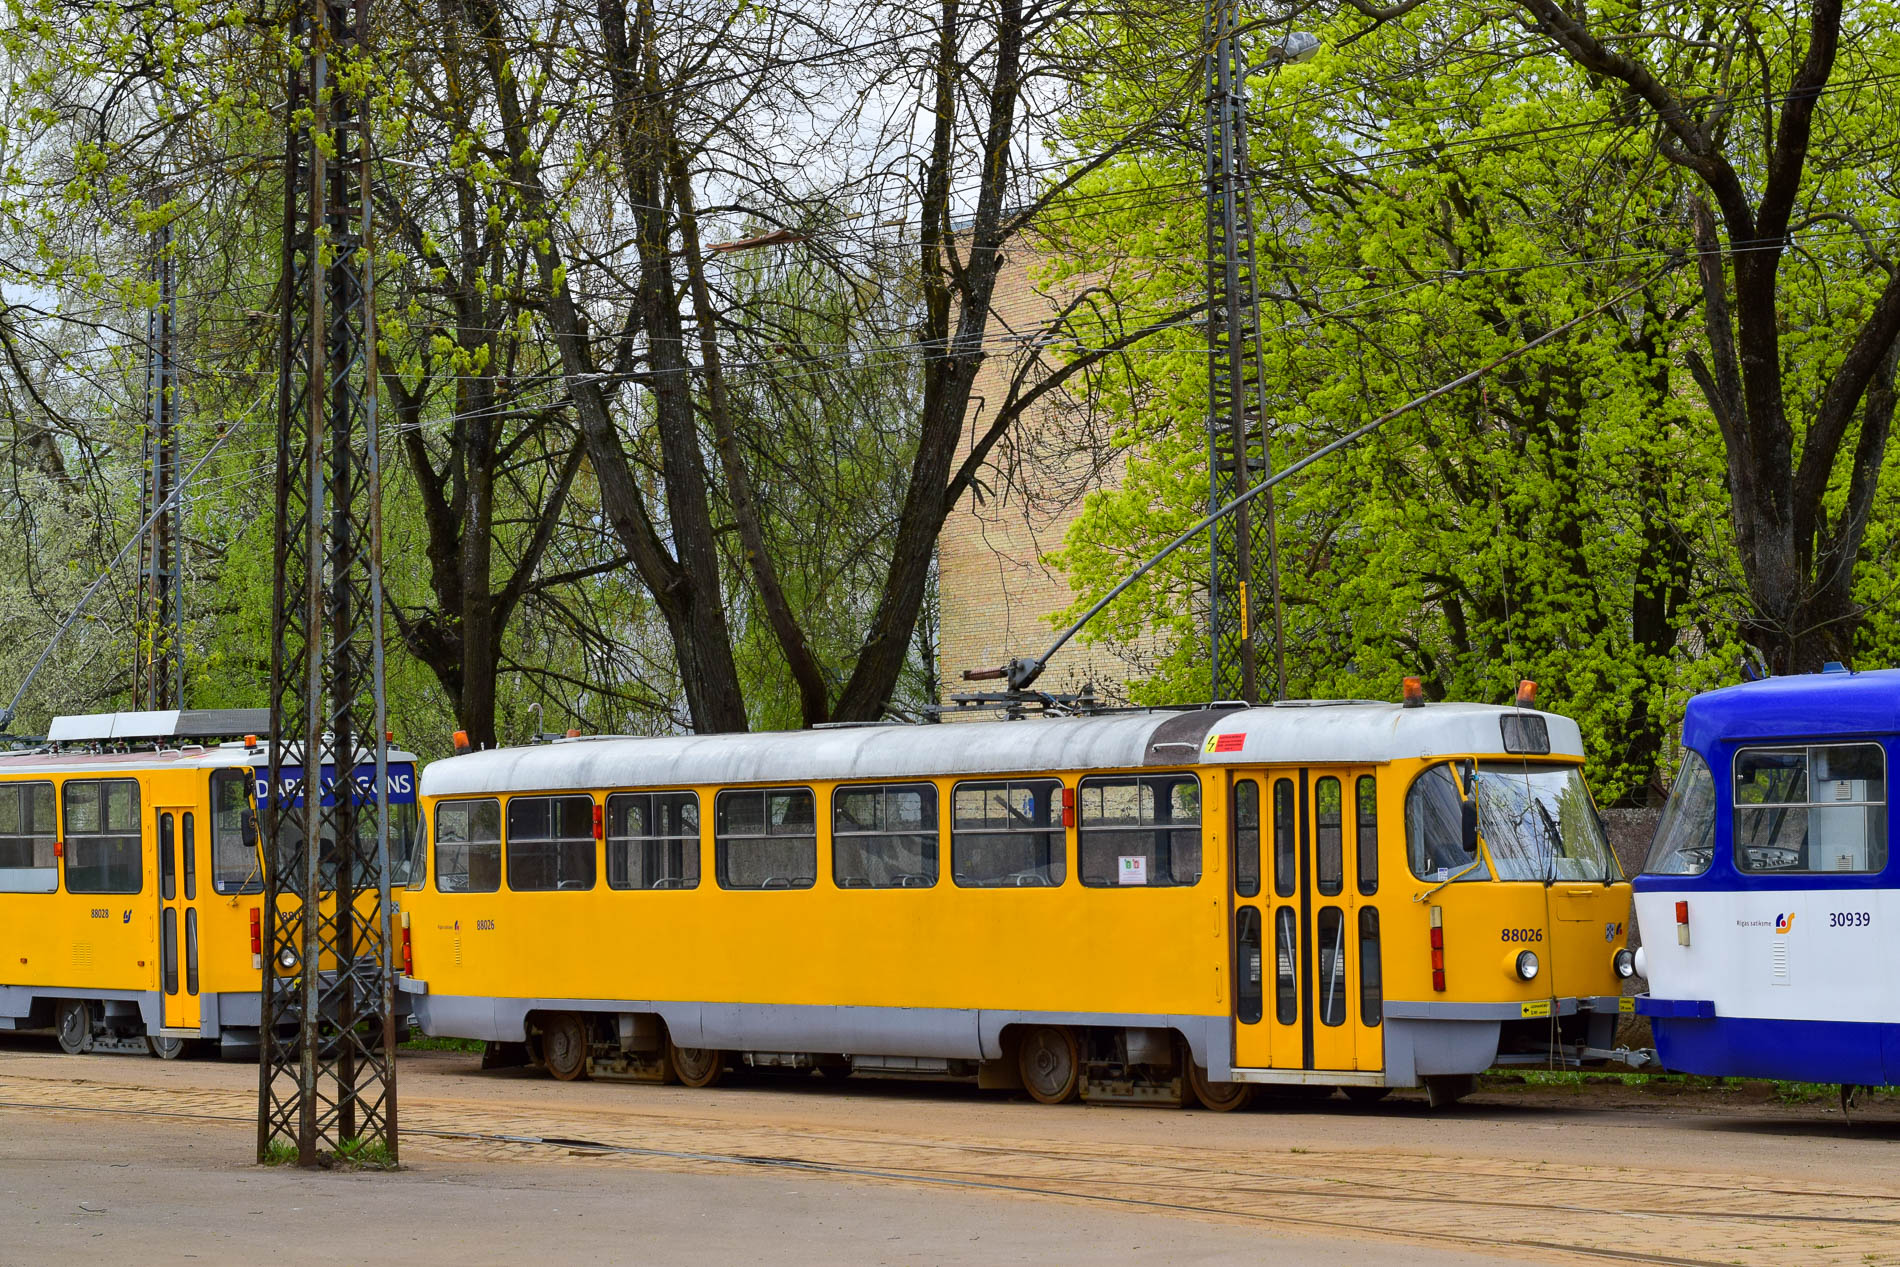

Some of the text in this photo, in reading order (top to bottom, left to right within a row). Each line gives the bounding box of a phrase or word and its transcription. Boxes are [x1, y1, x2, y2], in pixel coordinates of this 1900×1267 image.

[327, 775, 412, 797] GNS
[477, 919, 495, 931] 88026
[1829, 912, 1871, 928] 30939
[1501, 928, 1543, 942] 88026
